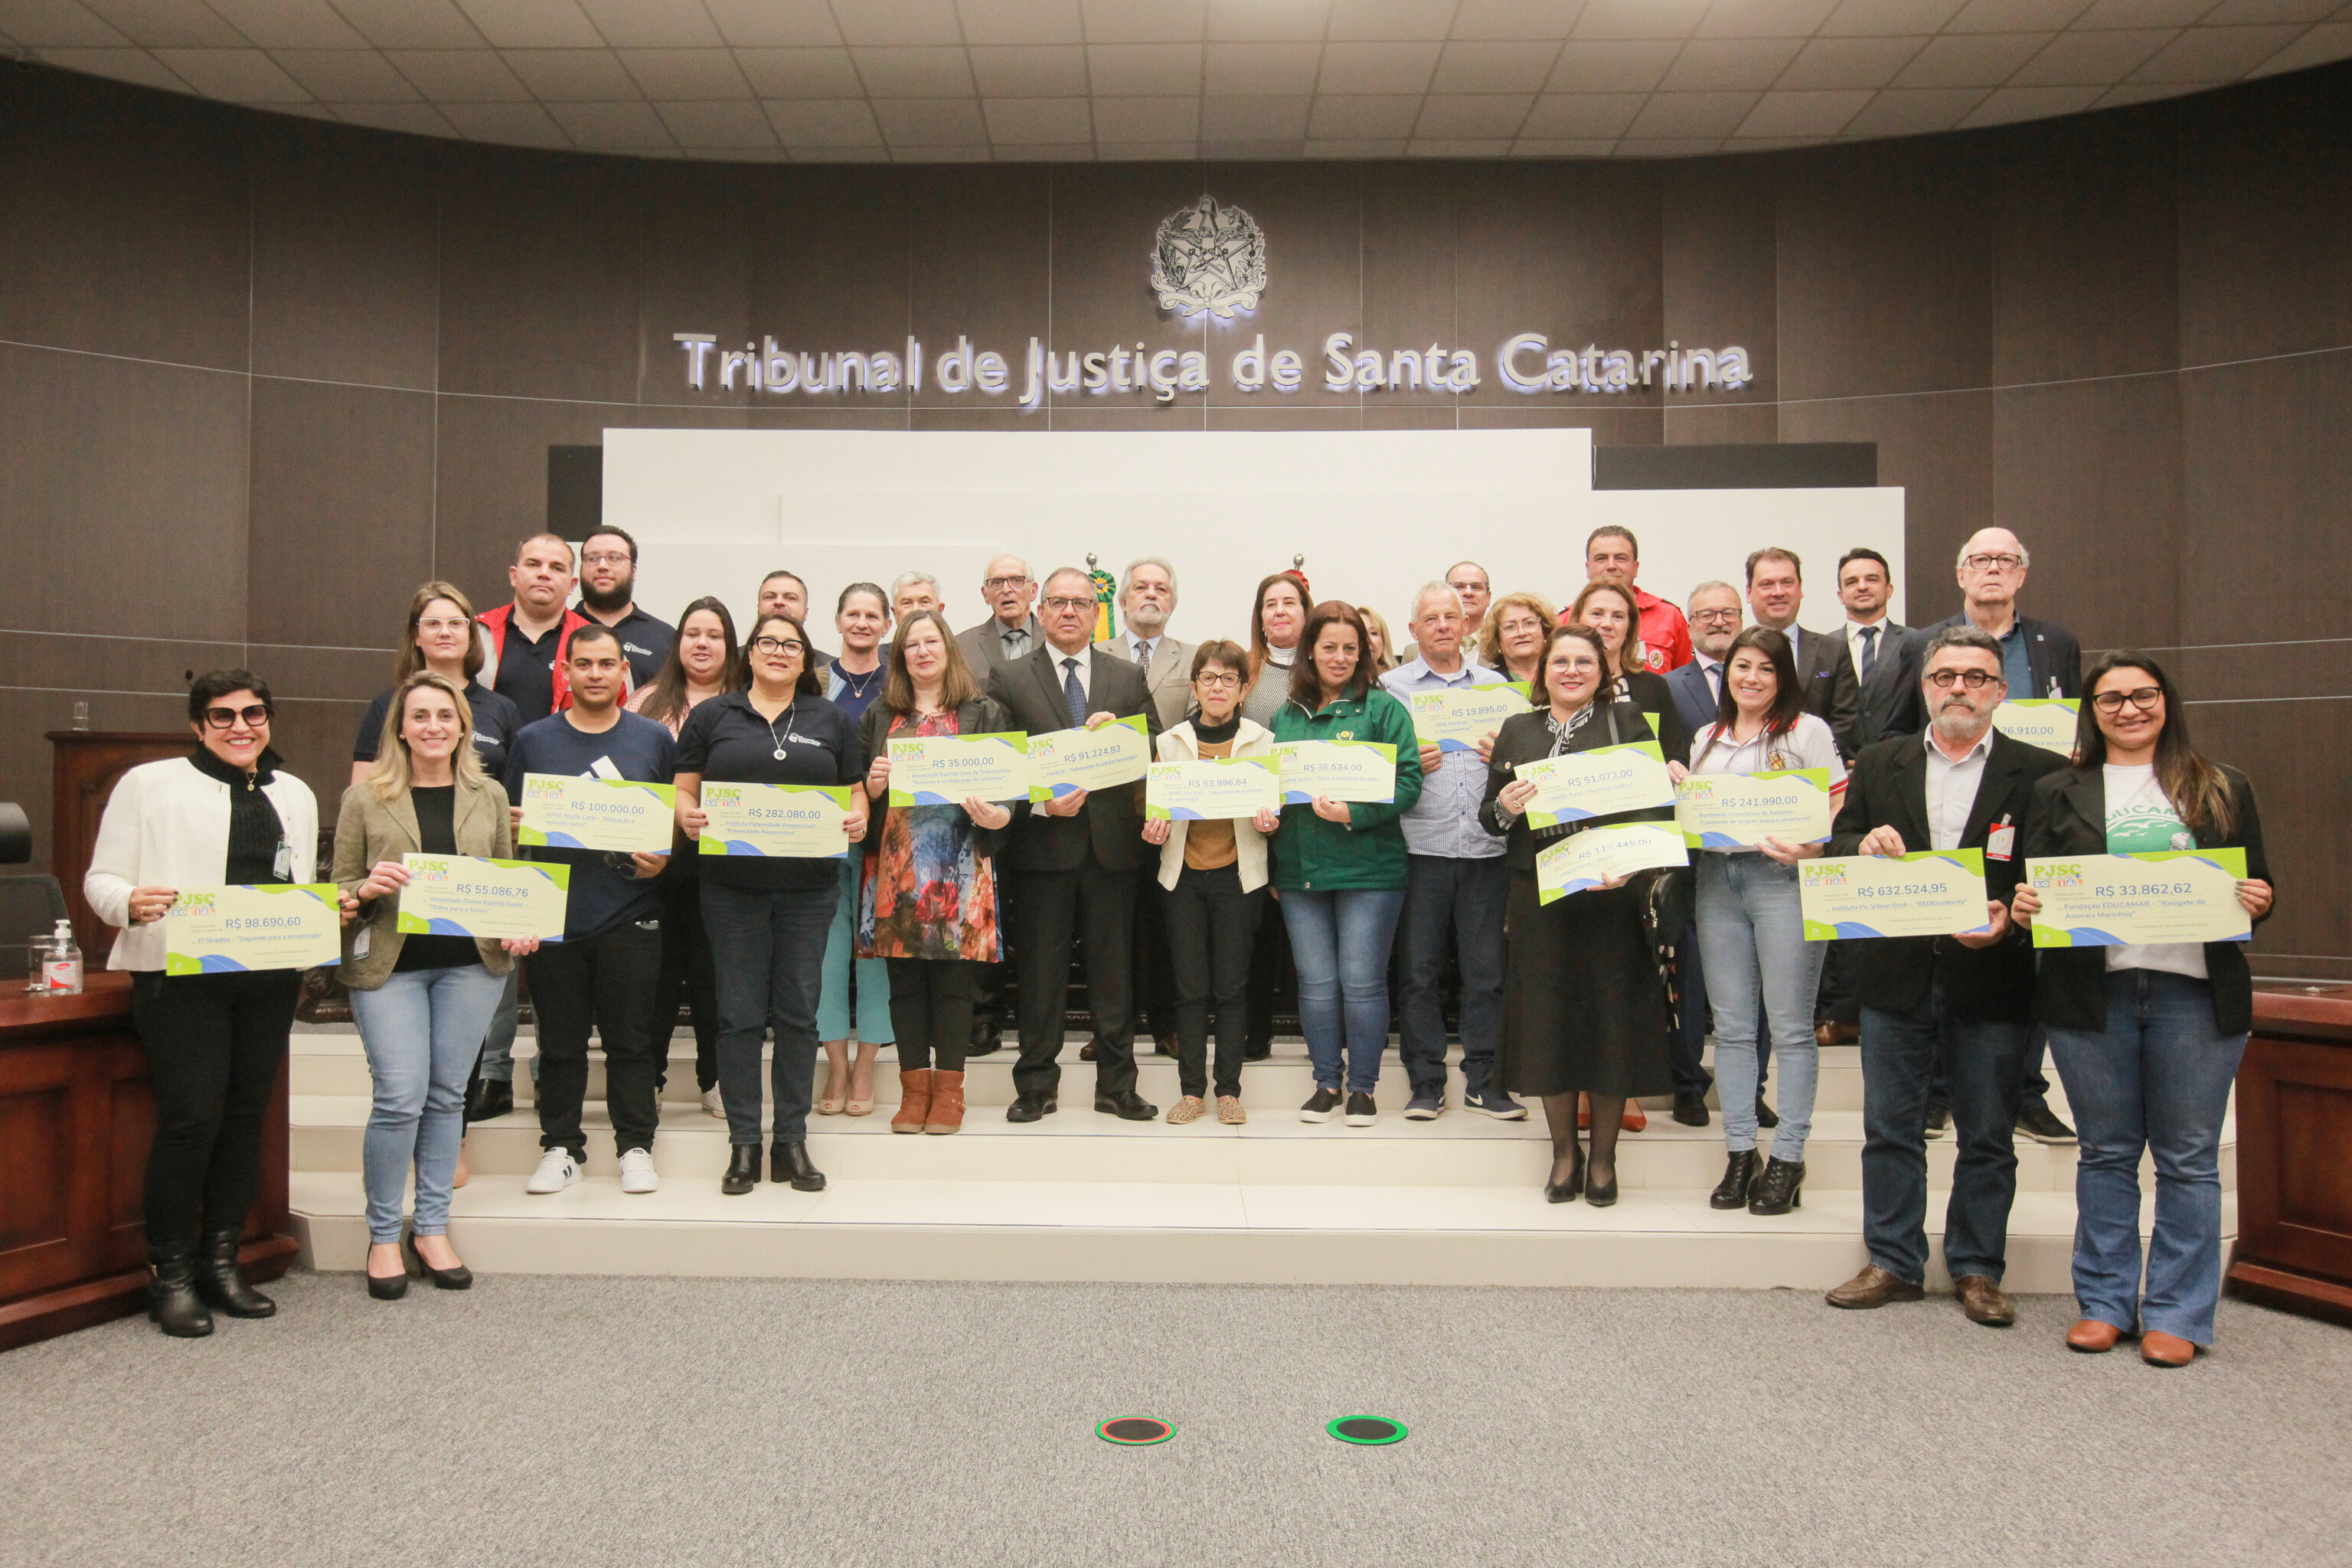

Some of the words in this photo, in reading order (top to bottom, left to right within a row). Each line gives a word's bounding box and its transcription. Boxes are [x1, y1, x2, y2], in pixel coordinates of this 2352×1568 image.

[674, 333, 915, 387] Tribunal
[936, 335, 1005, 387] de
[1019, 337, 1210, 402] Justiça
[1233, 334, 1302, 387] de
[1325, 333, 1481, 387] Santa
[1503, 333, 1753, 387] Catarina
[1413, 694, 1443, 704] PJSC
[1452, 709, 1463, 717] R$
[1466, 704, 1508, 716] 19.895,00
[2001, 727, 2054, 736] 26.910,00
[892, 743, 924, 753] PJSC
[1064, 753, 1076, 763] R$
[1078, 745, 1121, 760] 91.224,83
[1270, 746, 1298, 756] PJSC
[933, 759, 945, 769] R$
[948, 757, 994, 767] 35.000,00
[1151, 766, 1181, 774] PJSC
[1521, 763, 1555, 777] PJSC
[1203, 779, 1246, 787] 53.996,64
[1527, 773, 1558, 784] OCIAL
[1567, 777, 1582, 787] R$
[1584, 769, 1632, 784] 51.072,00
[528, 779, 565, 790] PJSC
[1679, 780, 1713, 791] PJSC
[705, 788, 741, 798] PJSC
[1722, 798, 1736, 807] R$
[1739, 795, 1798, 807] 241.990,00
[571, 801, 585, 811] R$
[589, 802, 645, 815] 100.000,00
[749, 808, 763, 818] R$
[766, 809, 821, 820] 282.080,00
[1540, 842, 1570, 861] PJSC
[1579, 850, 1592, 860] R$
[1595, 839, 1651, 854] 119445,00
[409, 859, 449, 871] PJSC
[1805, 864, 1846, 877] PJSC
[2033, 864, 2082, 877] PJSC
[1805, 877, 1847, 887] SOCIAL
[2034, 879, 2082, 888] SOCIAL
[456, 884, 472, 894] R$
[475, 885, 529, 897] 55.086,76
[1857, 887, 1874, 898] R$
[1877, 883, 1947, 896] 632.524,95
[2096, 885, 2115, 897] R$
[2119, 884, 2192, 896] 33.862,62
[2158, 899, 2194, 907] "Resgate
[172, 908, 215, 916] SOCIAL
[226, 918, 242, 929] R$
[245, 916, 301, 929] 98.690,60
